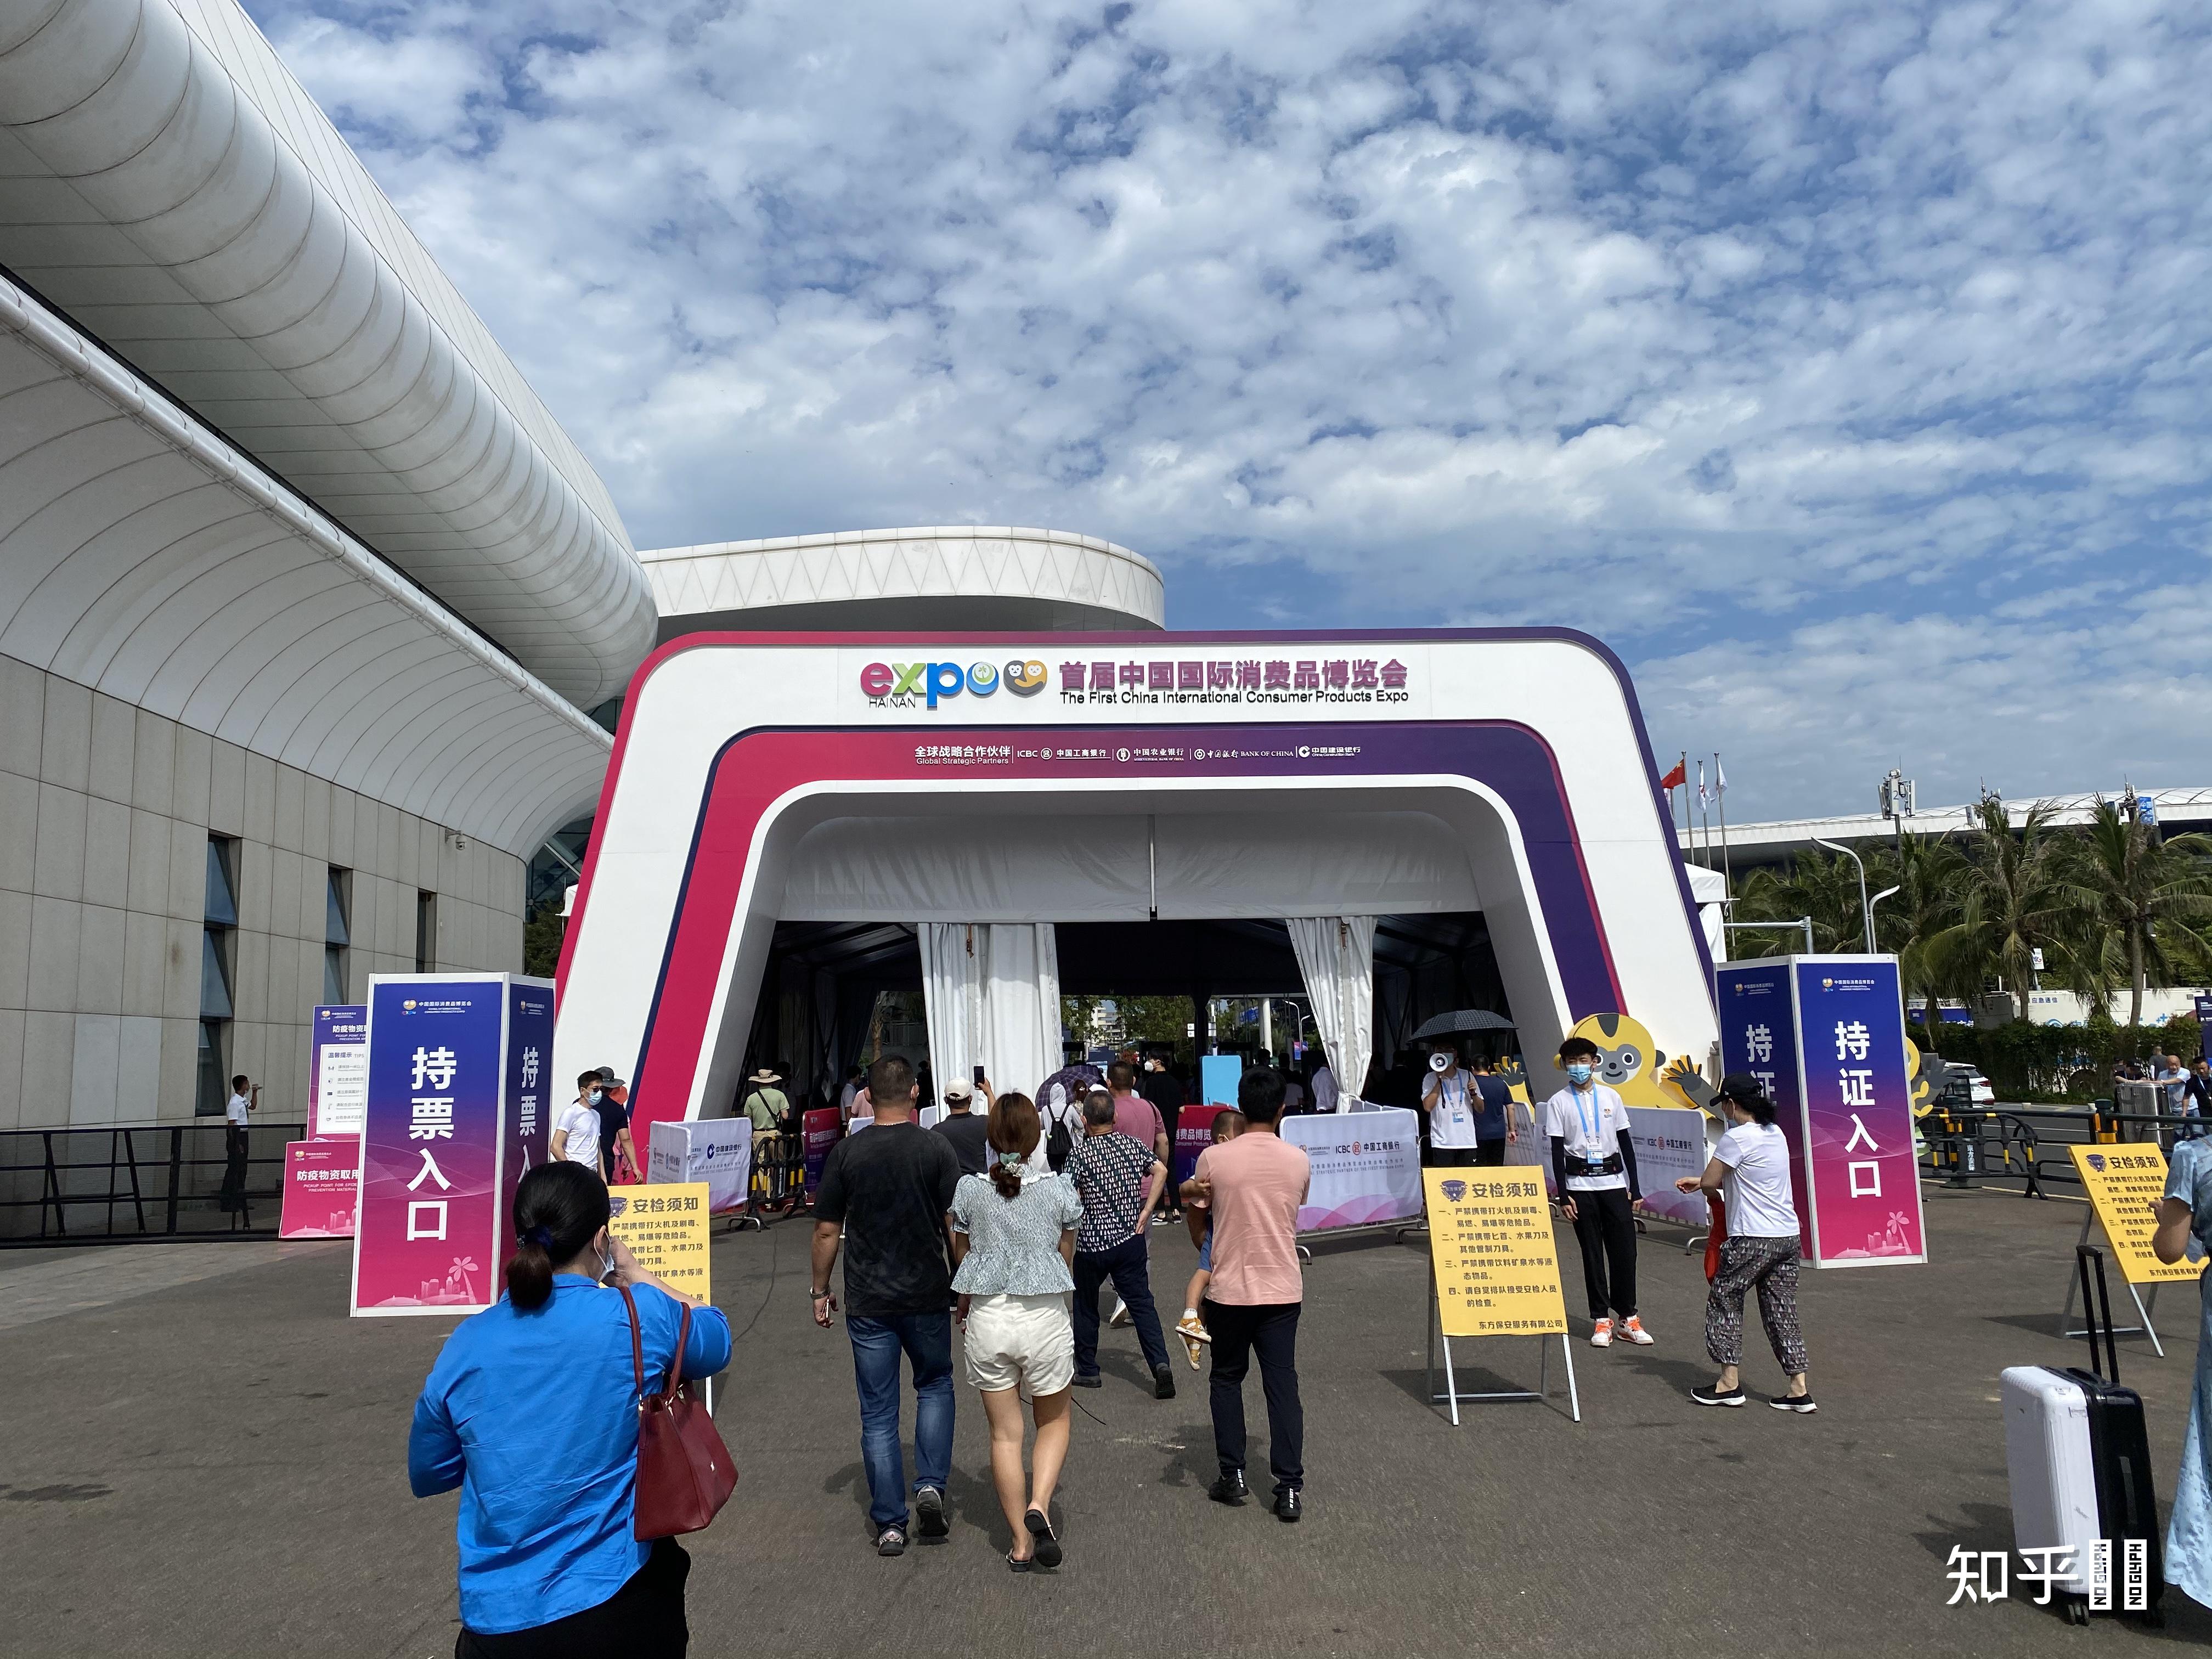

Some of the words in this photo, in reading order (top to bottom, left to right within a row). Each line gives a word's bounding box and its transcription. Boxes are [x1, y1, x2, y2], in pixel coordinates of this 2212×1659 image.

[1059, 659, 1408, 691] 首届中国国际消费品博览会
[1059, 692, 1085, 704] The
[1090, 691, 1118, 704] First
[1121, 691, 1159, 704] China
[1163, 691, 1242, 703] International
[1246, 690, 1313, 703] Consumer
[1316, 690, 1372, 702] Products
[1376, 690, 1409, 704] Expo
[869, 697, 916, 709] HAINAN
[915, 745, 1011, 758] 全球战略合作伙伴
[1056, 748, 1107, 757] 中国工商银行
[1133, 748, 1184, 757] 中国农业银行
[1207, 749, 1239, 759] 中国银行
[942, 758, 976, 766] Strategic
[1893, 790, 1899, 800] 2
[1835, 1021, 1882, 1198] 持证入口
[407, 1046, 457, 1242] 持票入口
[1335, 1145, 1351, 1154] ICBC
[1364, 1141, 1400, 1152] 中国工商银行
[2109, 1156, 2159, 1169] 安检须知
[297, 1169, 360, 1181] 防疫物资取用
[1472, 1182, 1538, 1198] 安检须知
[633, 1197, 698, 1214] 安检须知
[1460, 1245, 1514, 1253] 其他管制刀具。
[1445, 1258, 1553, 1268] 三、严禁携带饮料矿泉水等液
[1463, 1272, 1493, 1280] 态物品。
[1448, 1285, 1558, 1295] 四、请自觉排队接受安检人员
[1466, 1299, 1496, 1307] 的检查。
[1479, 1319, 1562, 1330] 东方保安服务有限公司
